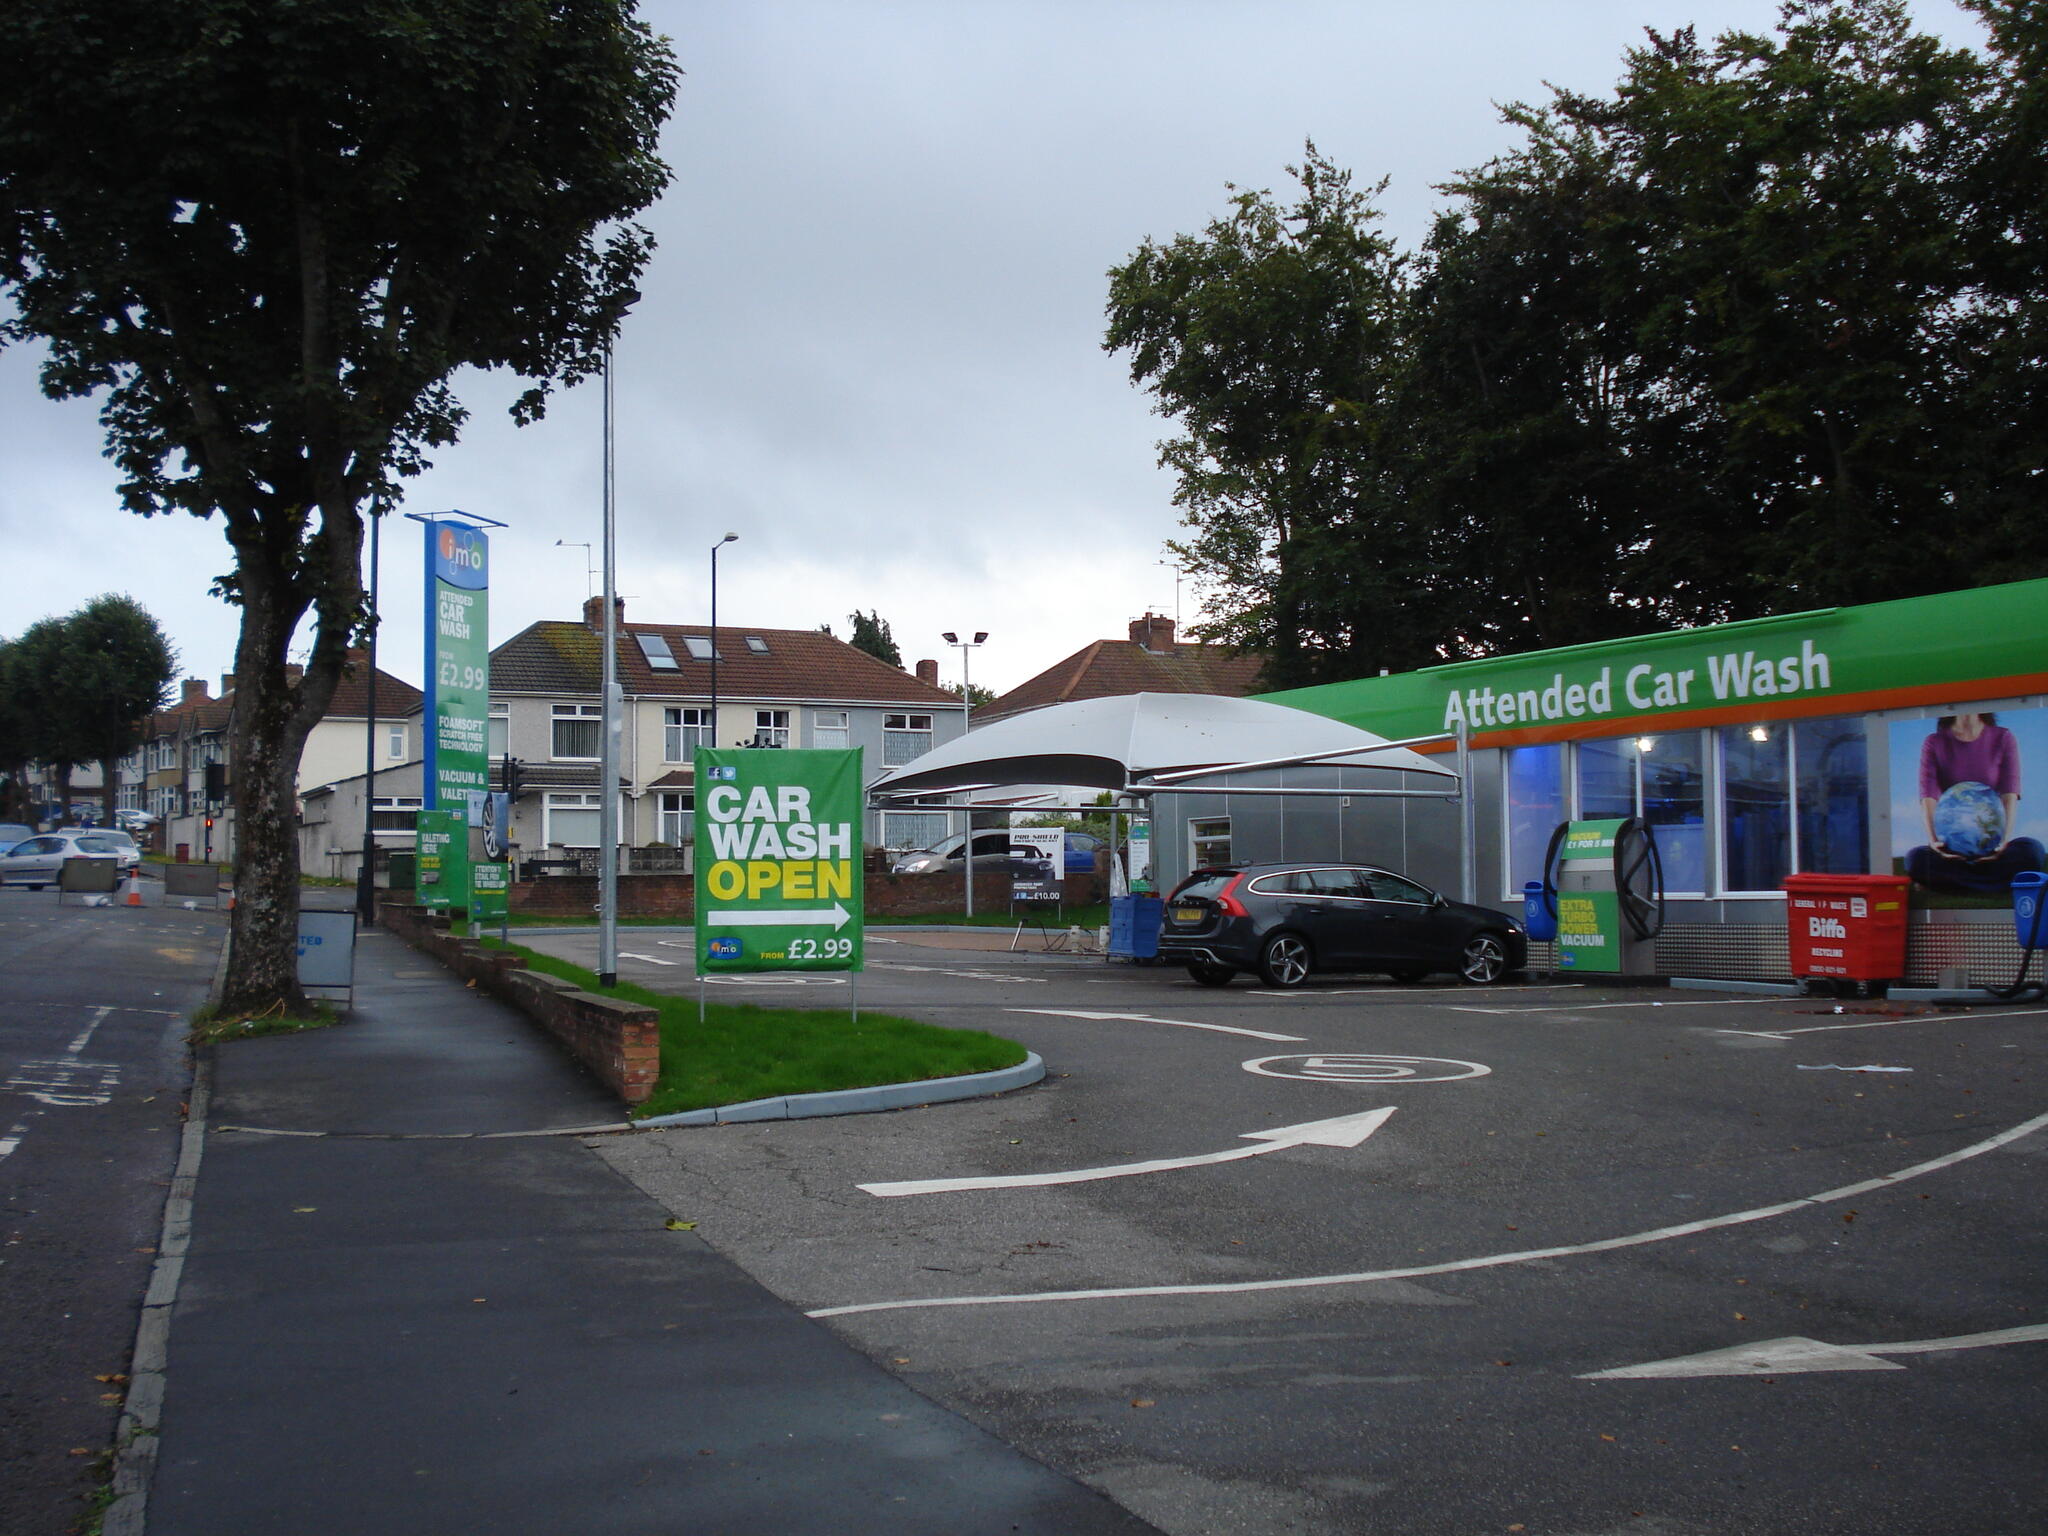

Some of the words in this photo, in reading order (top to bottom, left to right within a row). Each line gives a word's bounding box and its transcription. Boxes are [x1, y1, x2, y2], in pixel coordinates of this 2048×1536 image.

[448, 538, 481, 570] imo
[440, 590, 473, 607] ATTENDED
[440, 601, 465, 623] CAR
[440, 619, 470, 640] WASH
[439, 662, 485, 691] £2.99
[1443, 667, 1611, 730] Attended
[1625, 664, 1695, 709] Car
[1707, 639, 1832, 700] Wash
[439, 729, 466, 740] SCRATCH
[467, 732, 484, 742] FREE
[439, 739, 484, 753] TECHNOLOGY
[439, 770, 476, 784] VACUUM
[477, 772, 485, 785] &
[707, 785, 811, 823] CAR
[707, 823, 851, 860] WASH
[707, 860, 852, 900] OPEN
[1034, 891, 1060, 900] £10.00
[1560, 900, 1594, 911] EXTRA
[1560, 911, 1597, 923] TURBO
[1809, 916, 1846, 939] Biffa
[1560, 923, 1599, 935] POWER
[760, 951, 785, 960] FROM
[788, 938, 853, 960] £2.99
[1560, 934, 1605, 947] VACUUM
